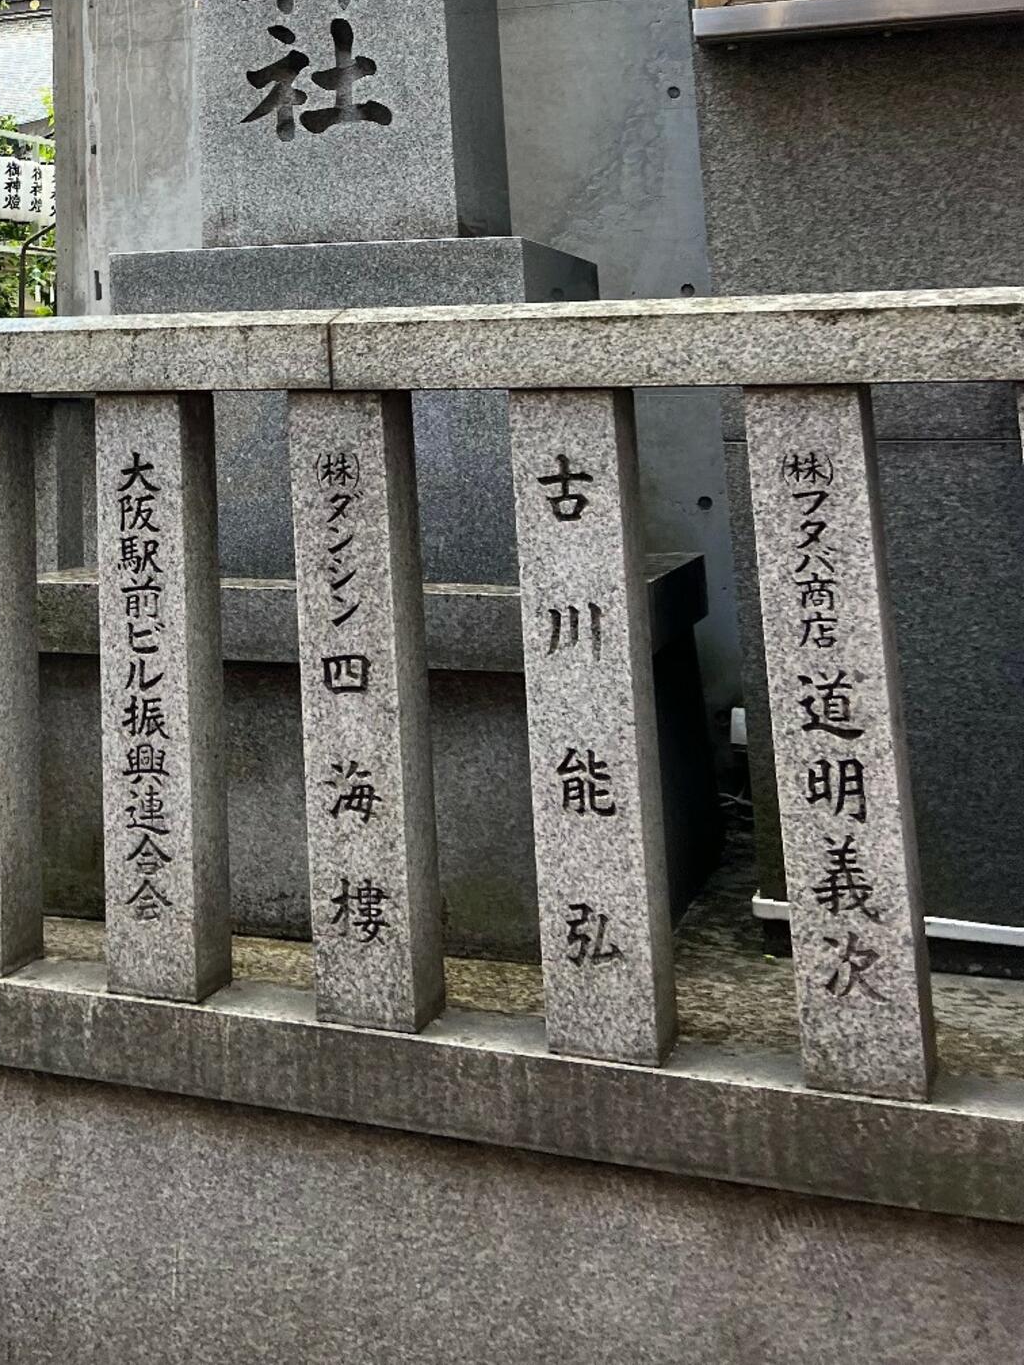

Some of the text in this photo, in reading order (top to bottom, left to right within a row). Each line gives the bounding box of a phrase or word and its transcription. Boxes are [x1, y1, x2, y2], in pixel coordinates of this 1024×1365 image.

[116, 451, 174, 922] 大阪駅前ビル振興連合会
[536, 454, 624, 968] 古川能弘
[798, 669, 887, 1002] 道明義次
